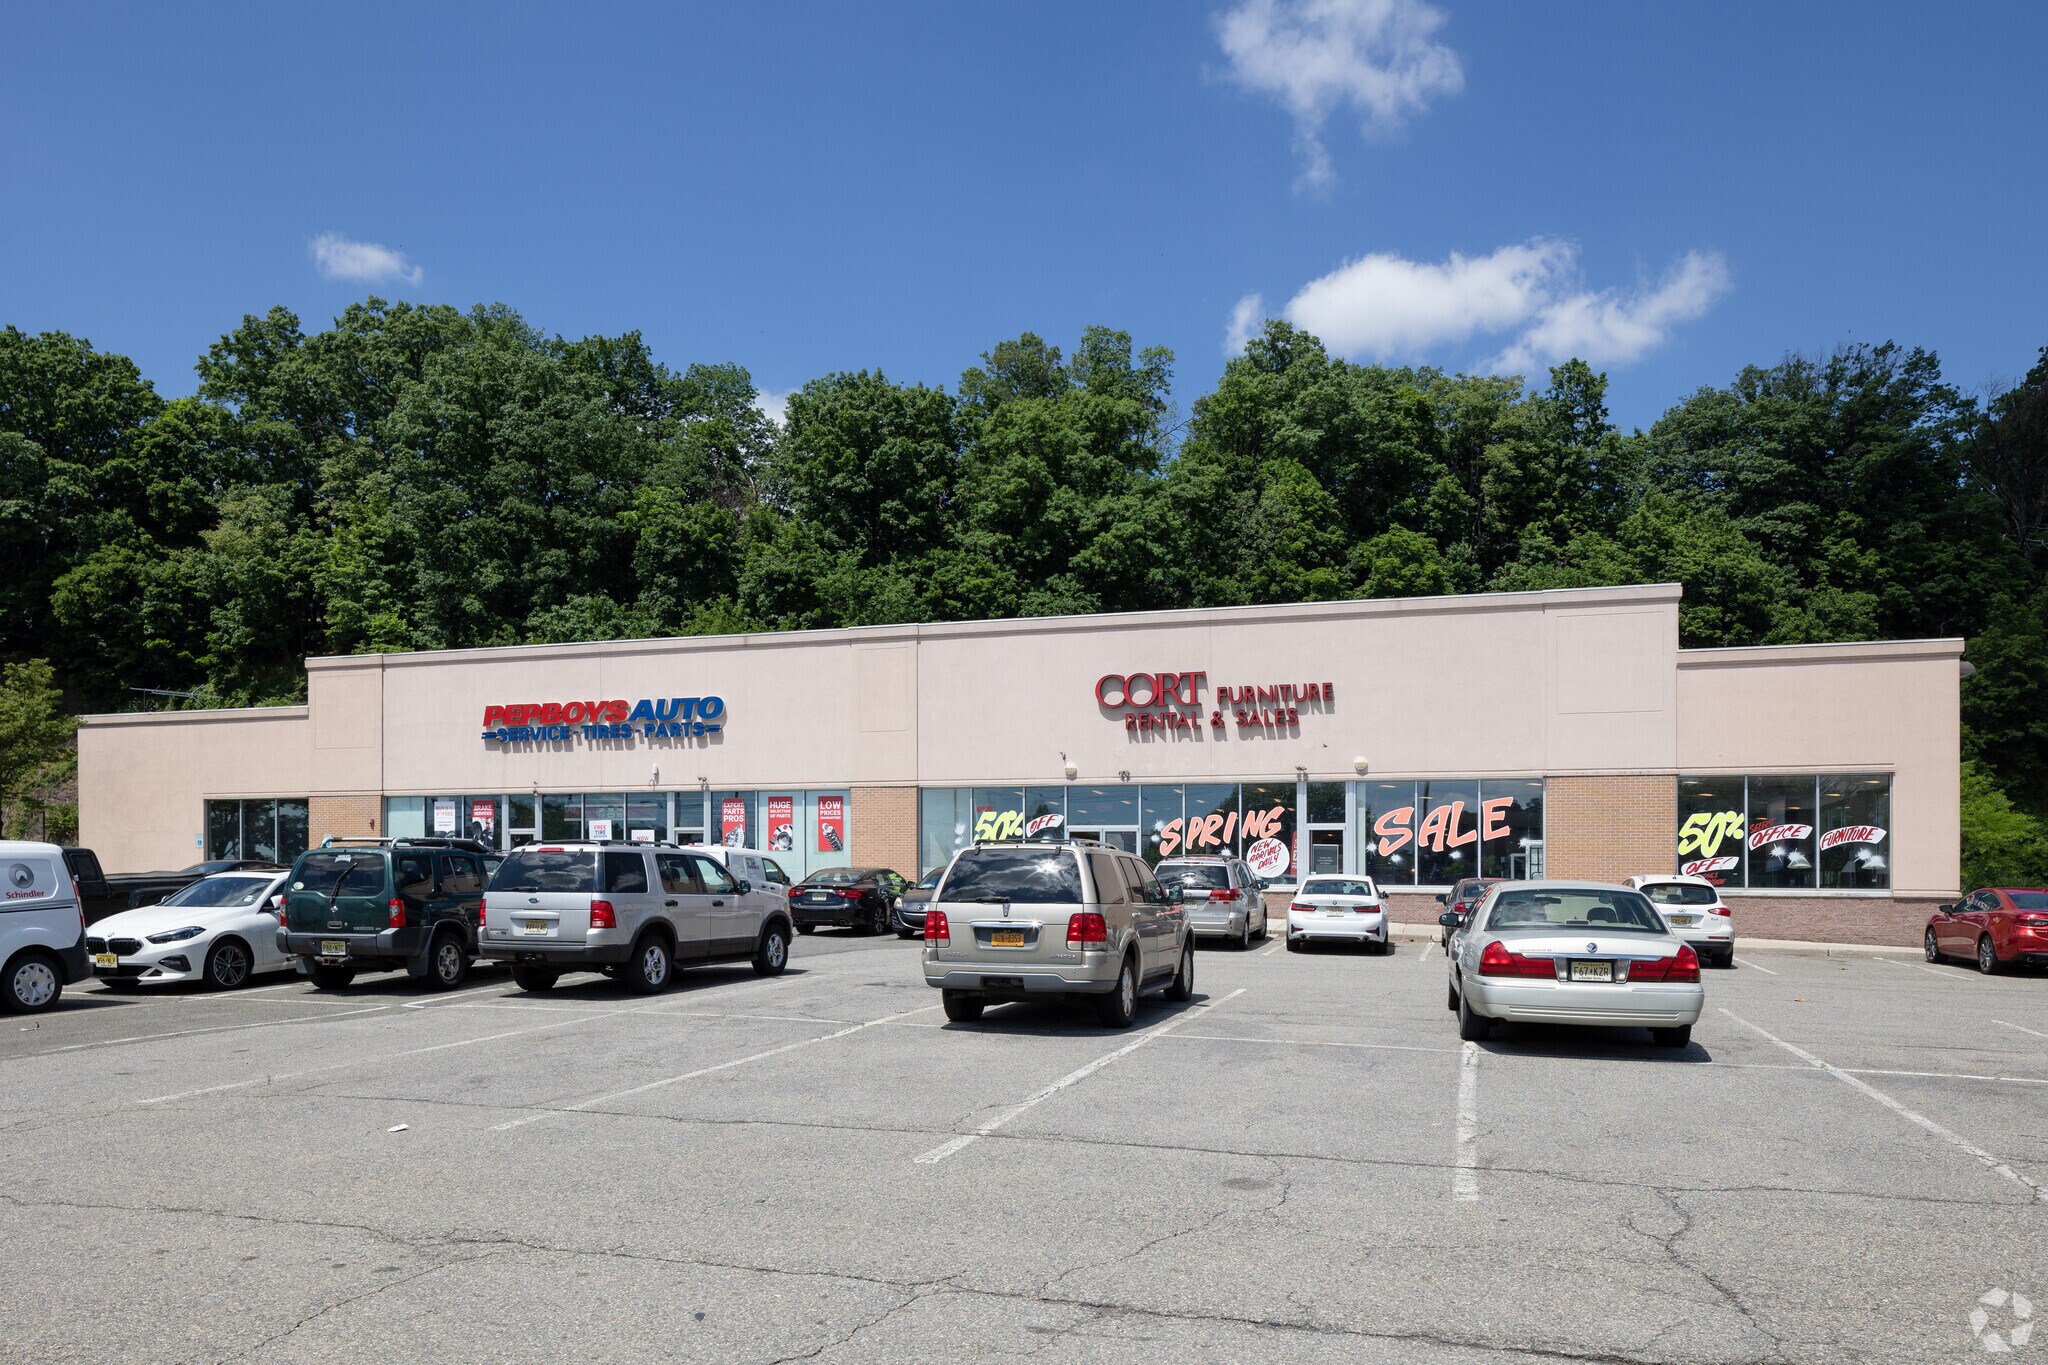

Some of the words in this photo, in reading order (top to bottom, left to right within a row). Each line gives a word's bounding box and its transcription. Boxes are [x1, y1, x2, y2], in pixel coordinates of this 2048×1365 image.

[1095, 671, 1207, 708] CORT
[1216, 682, 1333, 704] FURNITURE
[628, 696, 724, 722] AUTO
[1125, 711, 1201, 730] RENTAL
[1210, 711, 1225, 728] &
[1236, 708, 1299, 727] SALES
[769, 801, 791, 809] HUGE
[820, 801, 841, 810] LOW
[723, 815, 744, 823] PROS
[973, 810, 1023, 842] 50%
[1029, 814, 1060, 834] OFF
[1374, 796, 1514, 857] SALE
[1159, 806, 1285, 856] SPRING
[1678, 810, 1745, 858] 50%
[1752, 825, 1808, 847] OFFICE
[1821, 826, 1878, 849] FURNITURE
[1249, 842, 1282, 863] ARRIVALS
[1251, 839, 1274, 853] NEW
[1257, 853, 1280, 870] DAILY
[6, 890, 45, 899] Schindler
